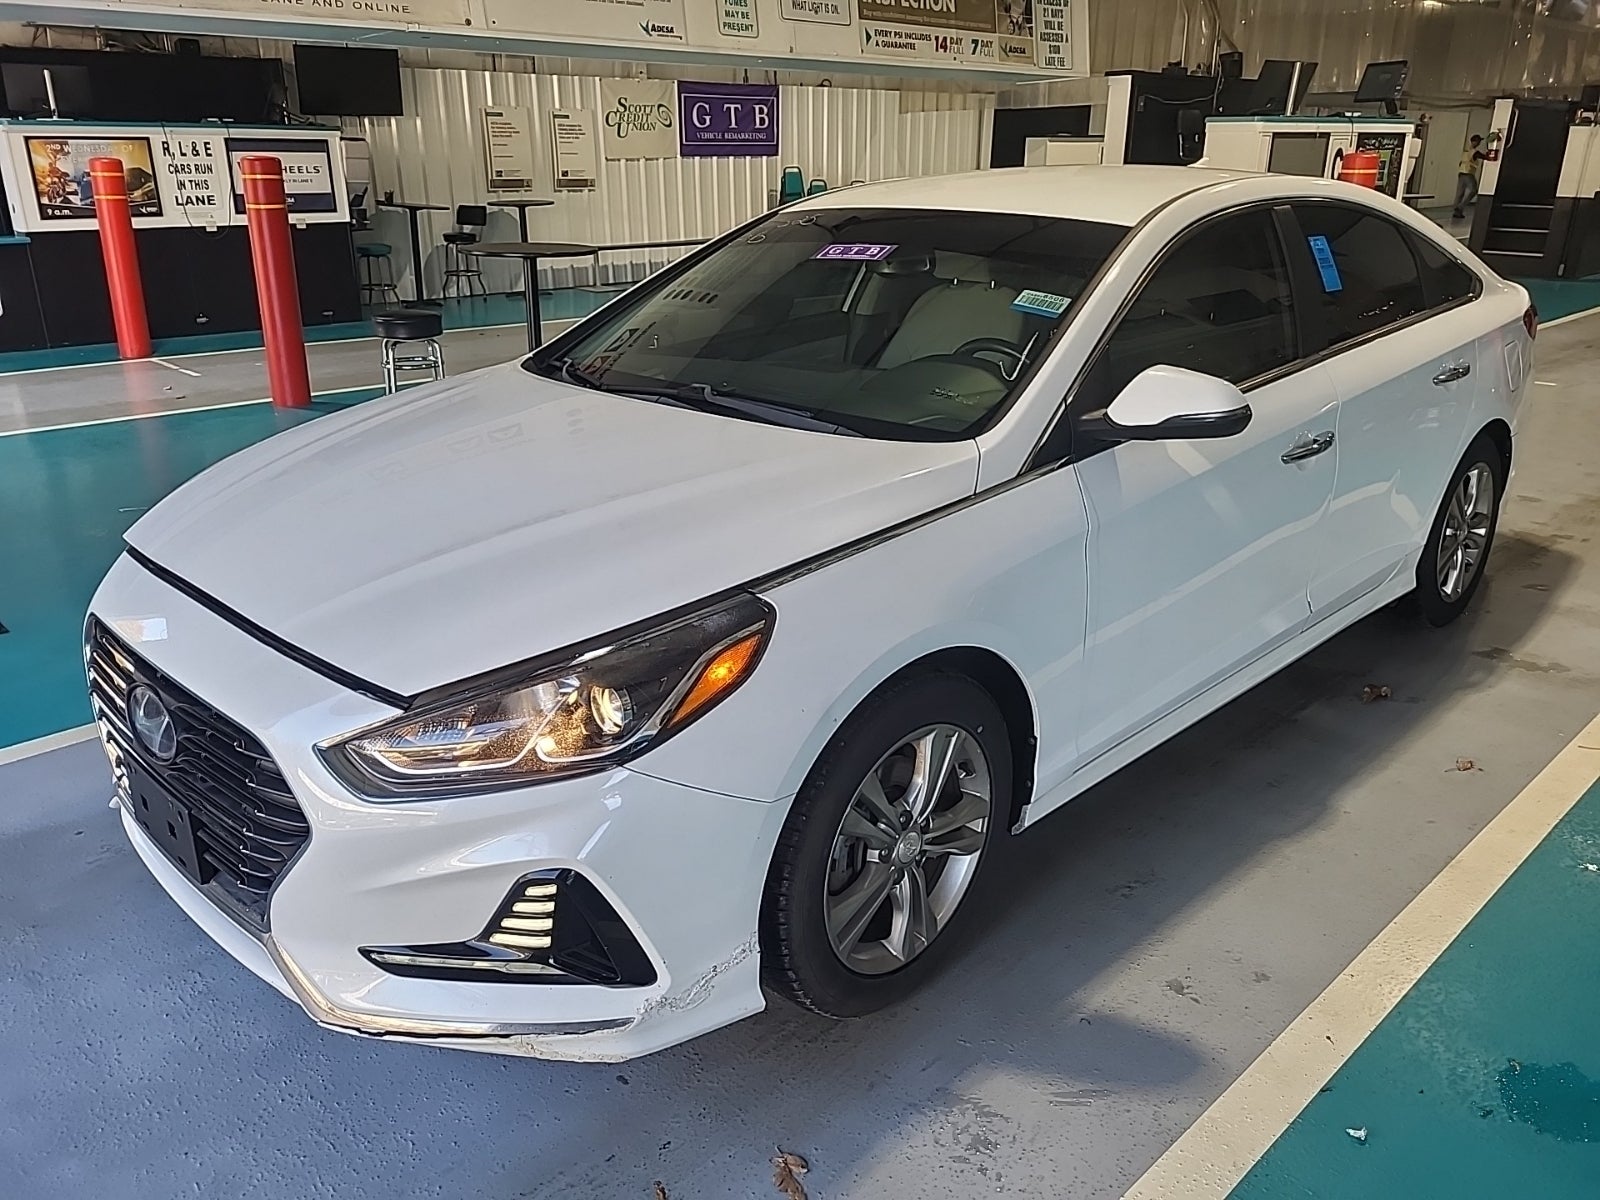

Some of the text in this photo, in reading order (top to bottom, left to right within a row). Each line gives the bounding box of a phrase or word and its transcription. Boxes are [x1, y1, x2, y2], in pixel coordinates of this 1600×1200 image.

[312, 0, 344, 8] AND
[353, 1, 411, 13] ONLINE
[792, 0, 807, 11] WHAT
[808, 2, 823, 13] LIGHT
[824, 4, 830, 13] IS
[863, 0, 956, 13] ECTION
[724, 10, 750, 19] MAY BE
[650, 24, 675, 33] ADESA
[723, 22, 754, 32] PRESENT
[1044, 20, 1056, 30] WILL
[874, 29, 932, 41] EVERY PSI INCLUDES
[881, 40, 916, 51] GUARANTEE
[934, 35, 948, 53] 14
[949, 37, 963, 46] DAY
[970, 39, 980, 55] 7
[980, 40, 994, 49] DAY
[949, 45, 964, 55] FULL
[980, 48, 994, 57] FULL
[1045, 56, 1065, 67] LATE FEE
[617, 97, 655, 113] SCOTT
[605, 110, 651, 127] CREDIT
[617, 122, 657, 138] UNION
[724, 132, 767, 140] REMARKETING
[46, 143, 62, 153] 2ND
[62, 144, 118, 153] WEDNESDA
[191, 141, 201, 157] &
[204, 141, 213, 157] E
[168, 164, 214, 174] CARS RUN
[281, 165, 321, 174] HEELS
[177, 179, 210, 191] IN THIS
[175, 195, 216, 206] LANE
